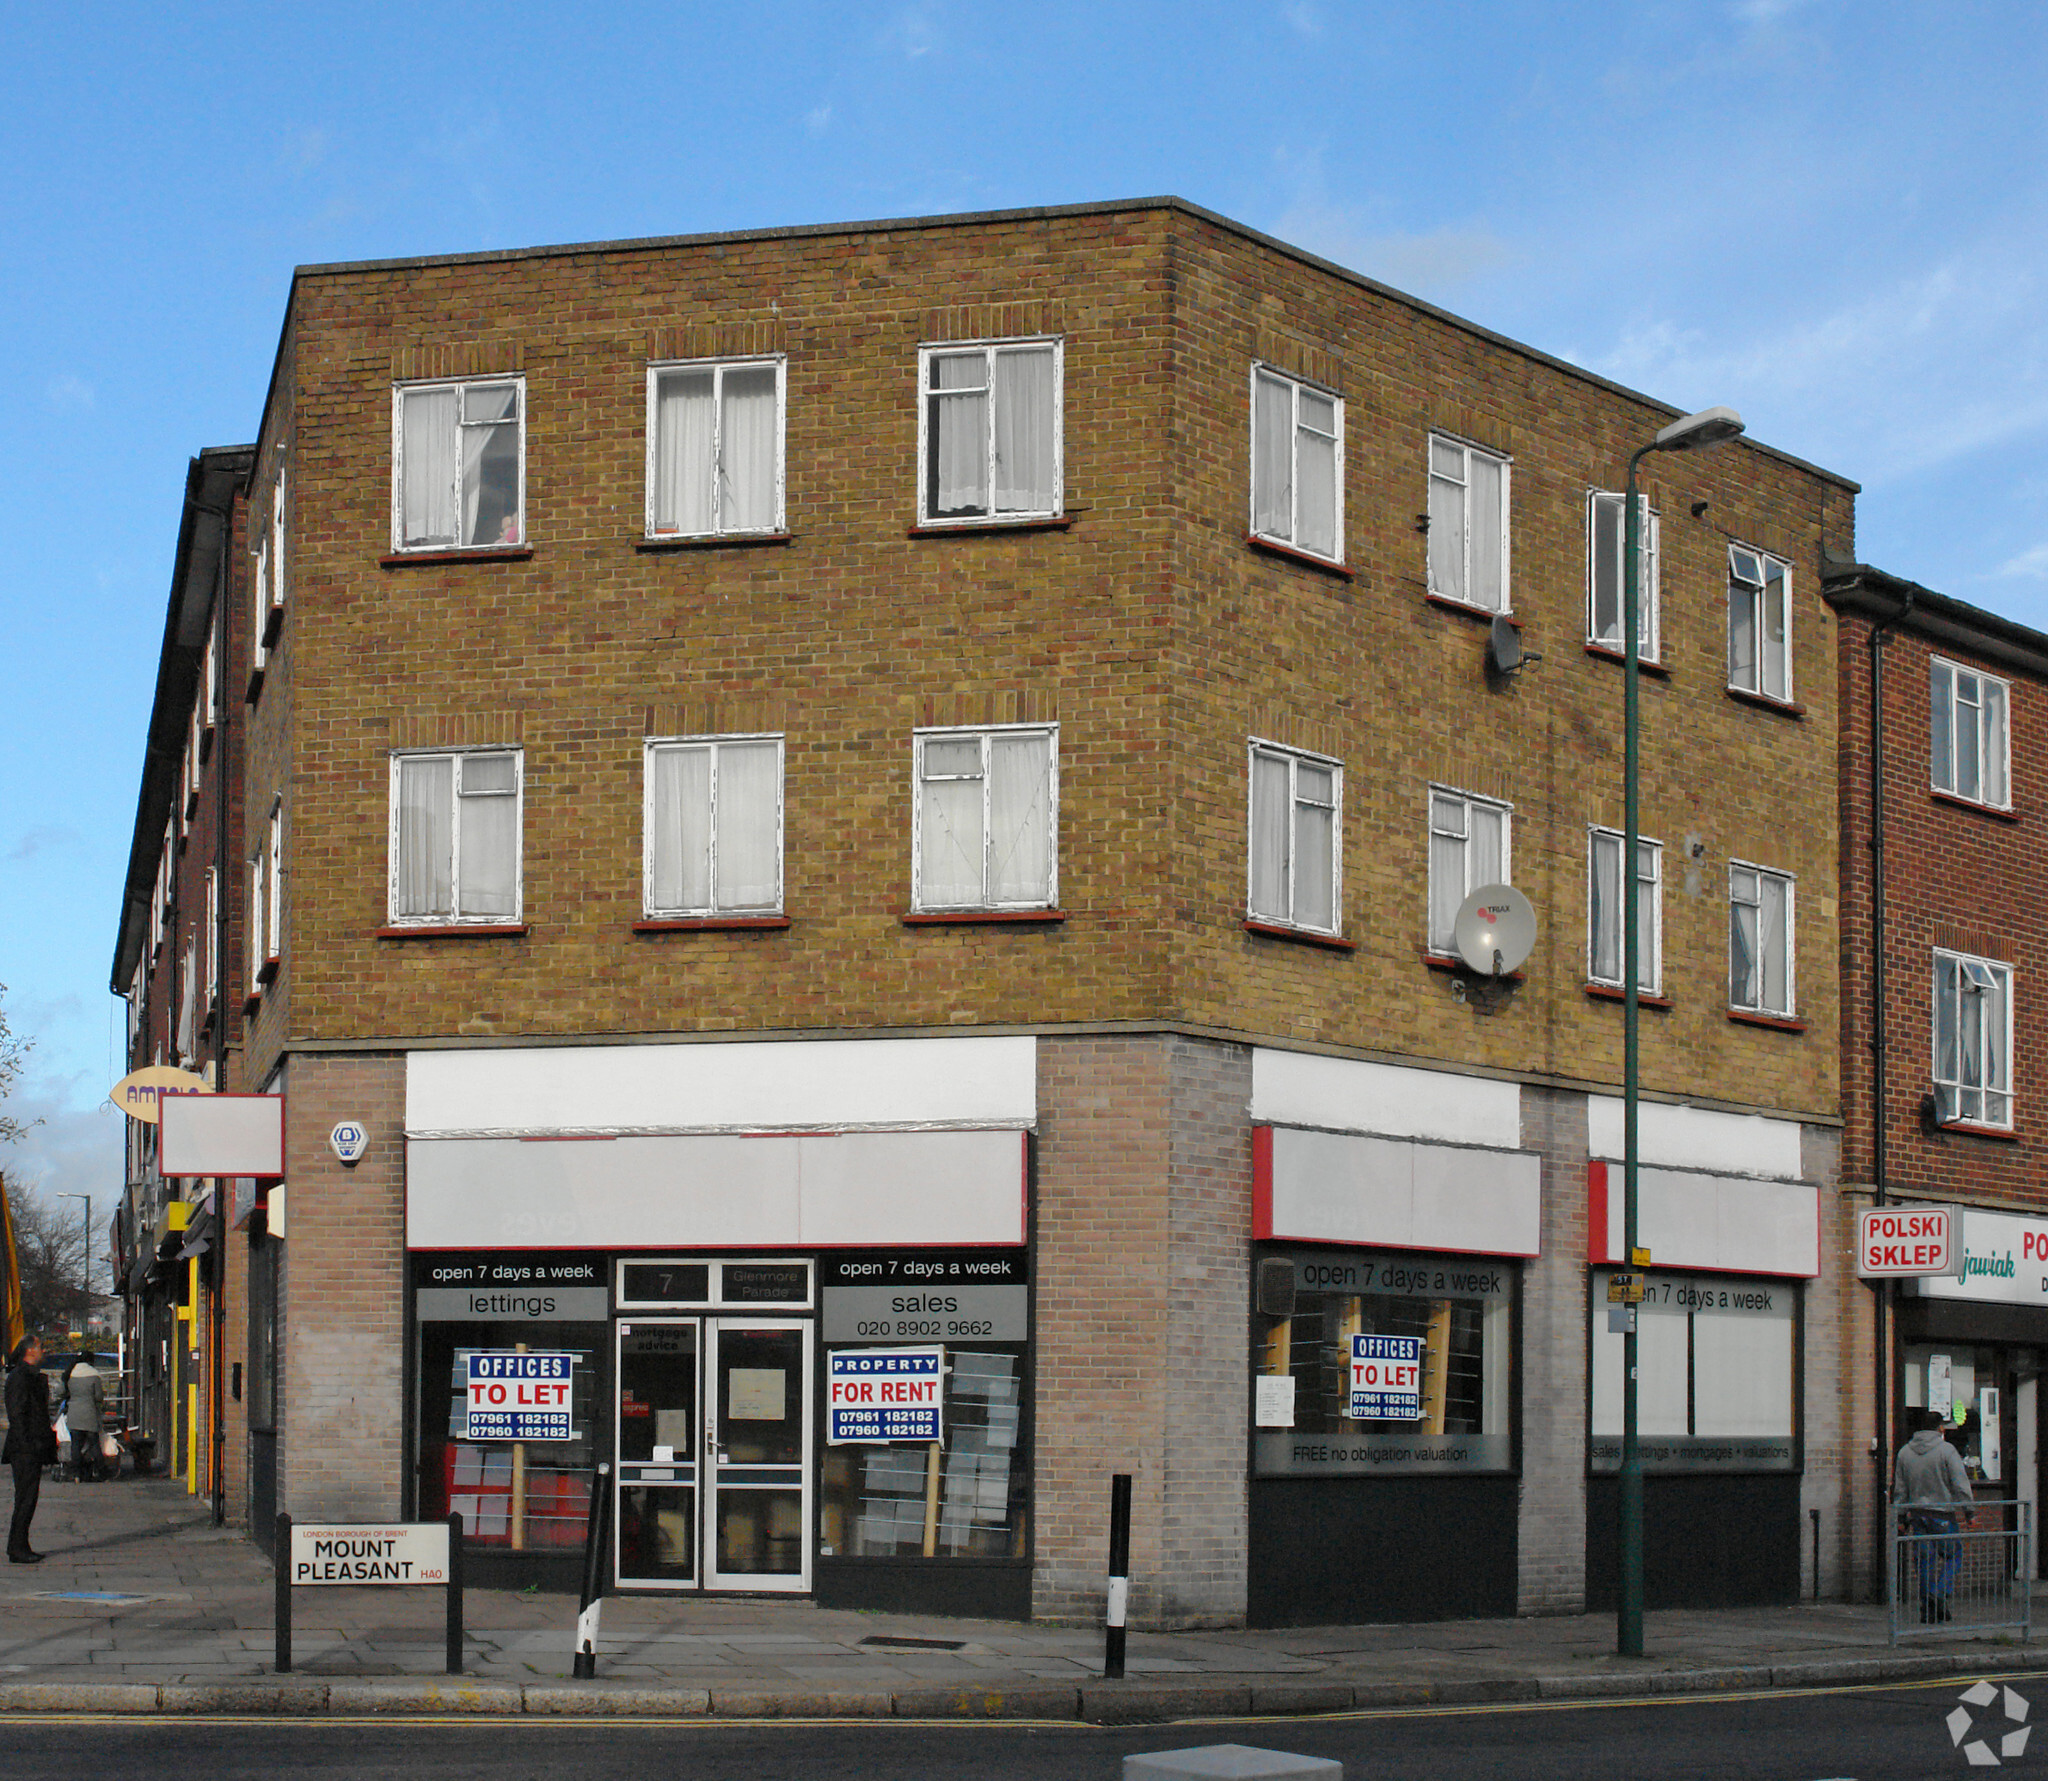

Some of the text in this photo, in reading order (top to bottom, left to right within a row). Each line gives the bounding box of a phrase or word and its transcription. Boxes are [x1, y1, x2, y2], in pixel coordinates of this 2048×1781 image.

[1488, 905, 1511, 913] TRIAX
[1870, 1216, 1942, 1238] POLSKI
[1869, 1244, 1941, 1266] SKLEP
[432, 1264, 594, 1282] open 7 days a week
[839, 1260, 1011, 1278] open 7 days a week
[1957, 1247, 2016, 1286] jawiak
[659, 1273, 673, 1294] 7
[1304, 1263, 1500, 1293] open 7 days a week
[742, 1286, 789, 1298] Parade
[1661, 1283, 1671, 1304] 7
[1676, 1285, 1714, 1310] days
[1719, 1291, 1728, 1307] a
[1732, 1290, 1772, 1310] week
[469, 1293, 556, 1316] lettings
[891, 1293, 958, 1312] sales
[857, 1321, 992, 1335] 020 8902 9662
[1359, 1338, 1413, 1359] OFFICES
[479, 1358, 562, 1377] OFFICES
[834, 1359, 936, 1371] PROPERTY
[1352, 1364, 1418, 1386] TO LET
[469, 1384, 569, 1405] TO LET
[832, 1381, 937, 1402] FOR RENT
[1353, 1393, 1416, 1405] 07961 182182
[470, 1413, 568, 1424] 07961 182182
[839, 1411, 934, 1422] 07961 182182
[1352, 1406, 1416, 1417] 07960 182182
[470, 1426, 568, 1437] 07960 182182
[839, 1424, 933, 1435] 07960 182182
[1293, 1446, 1467, 1464] FREE no obligation valuation
[1591, 1444, 1621, 1458] sales
[303, 1530, 334, 1538] LONDON
[335, 1530, 372, 1538] BOROUGH
[315, 1540, 396, 1558] MOUNT
[298, 1562, 413, 1580] PLEASANT
